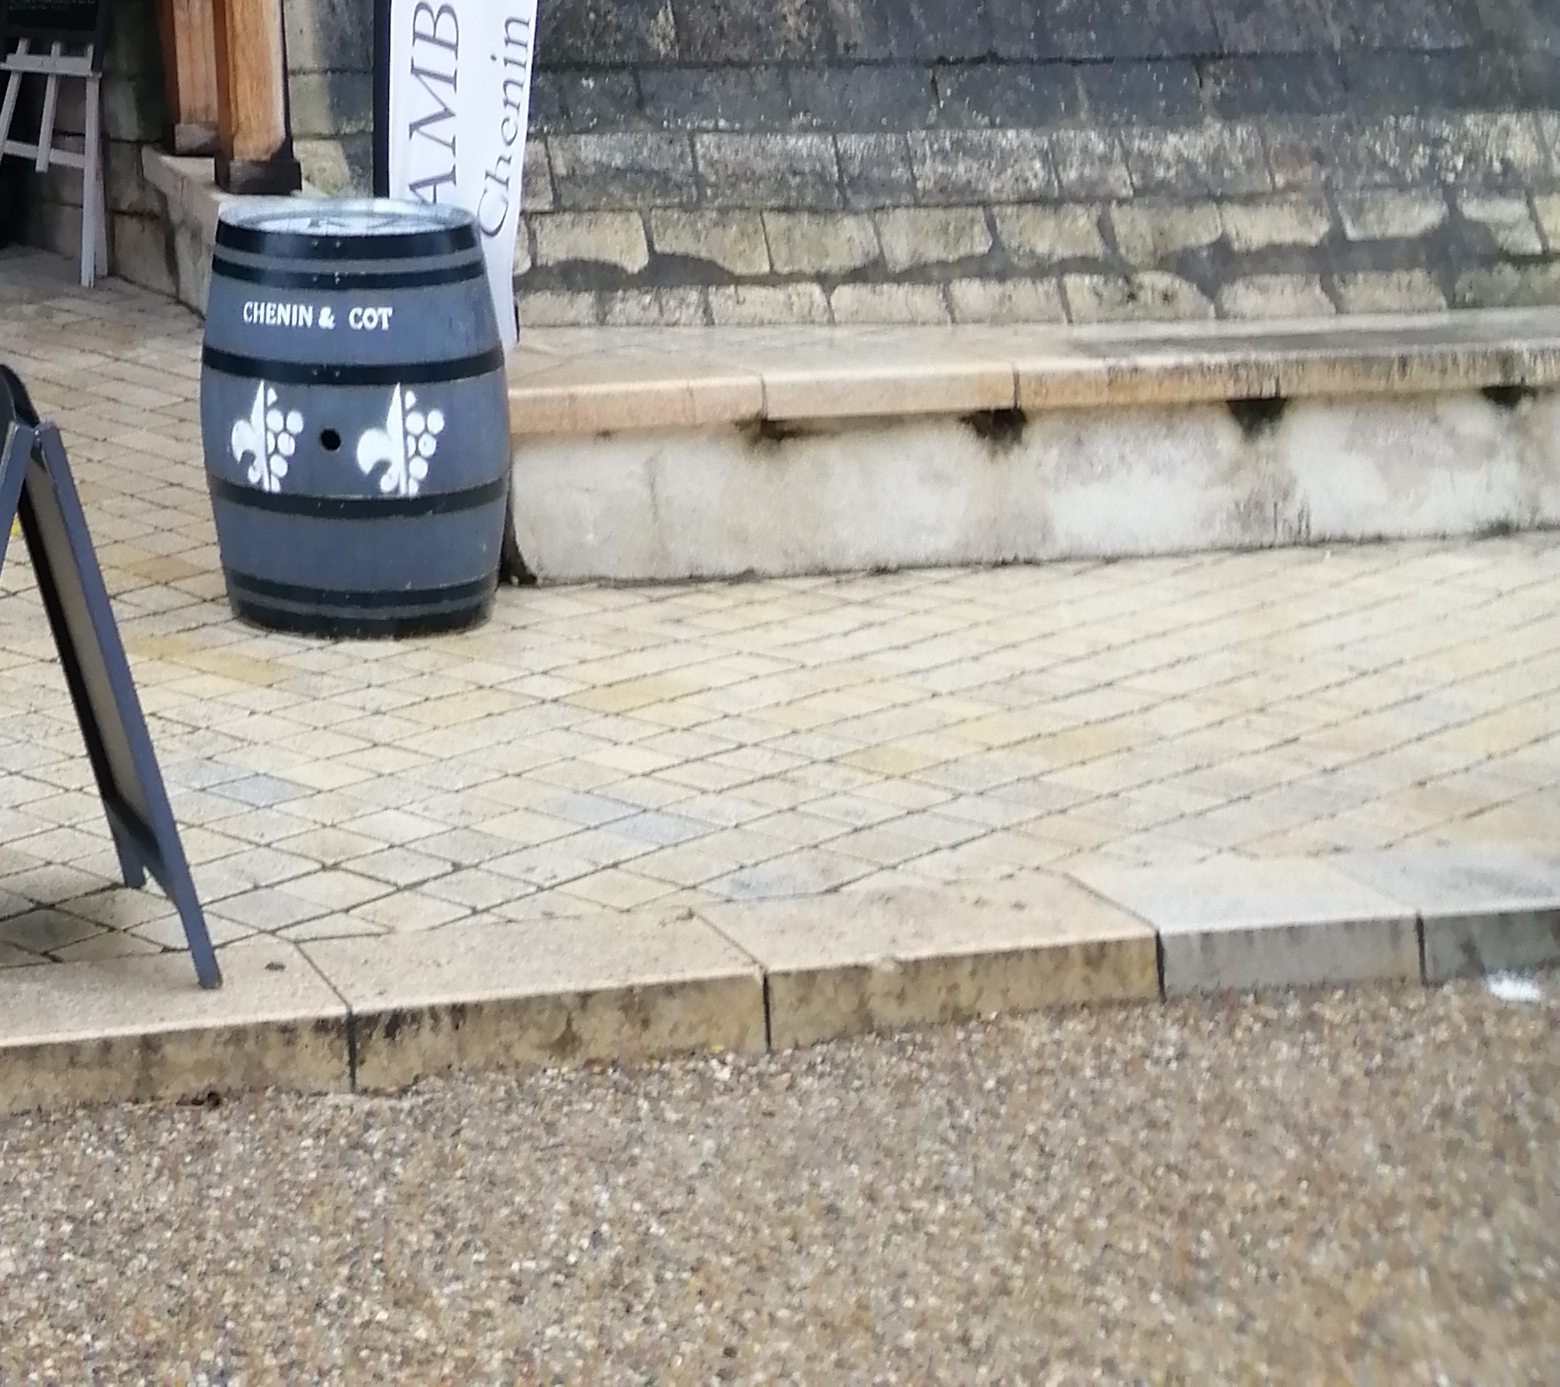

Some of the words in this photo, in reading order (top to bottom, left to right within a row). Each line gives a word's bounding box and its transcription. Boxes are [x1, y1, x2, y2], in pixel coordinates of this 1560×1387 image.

[478, 16, 530, 237] Chenin
[243, 301, 313, 327] CHENIN
[318, 307, 336, 329] &
[348, 307, 393, 331] COT
